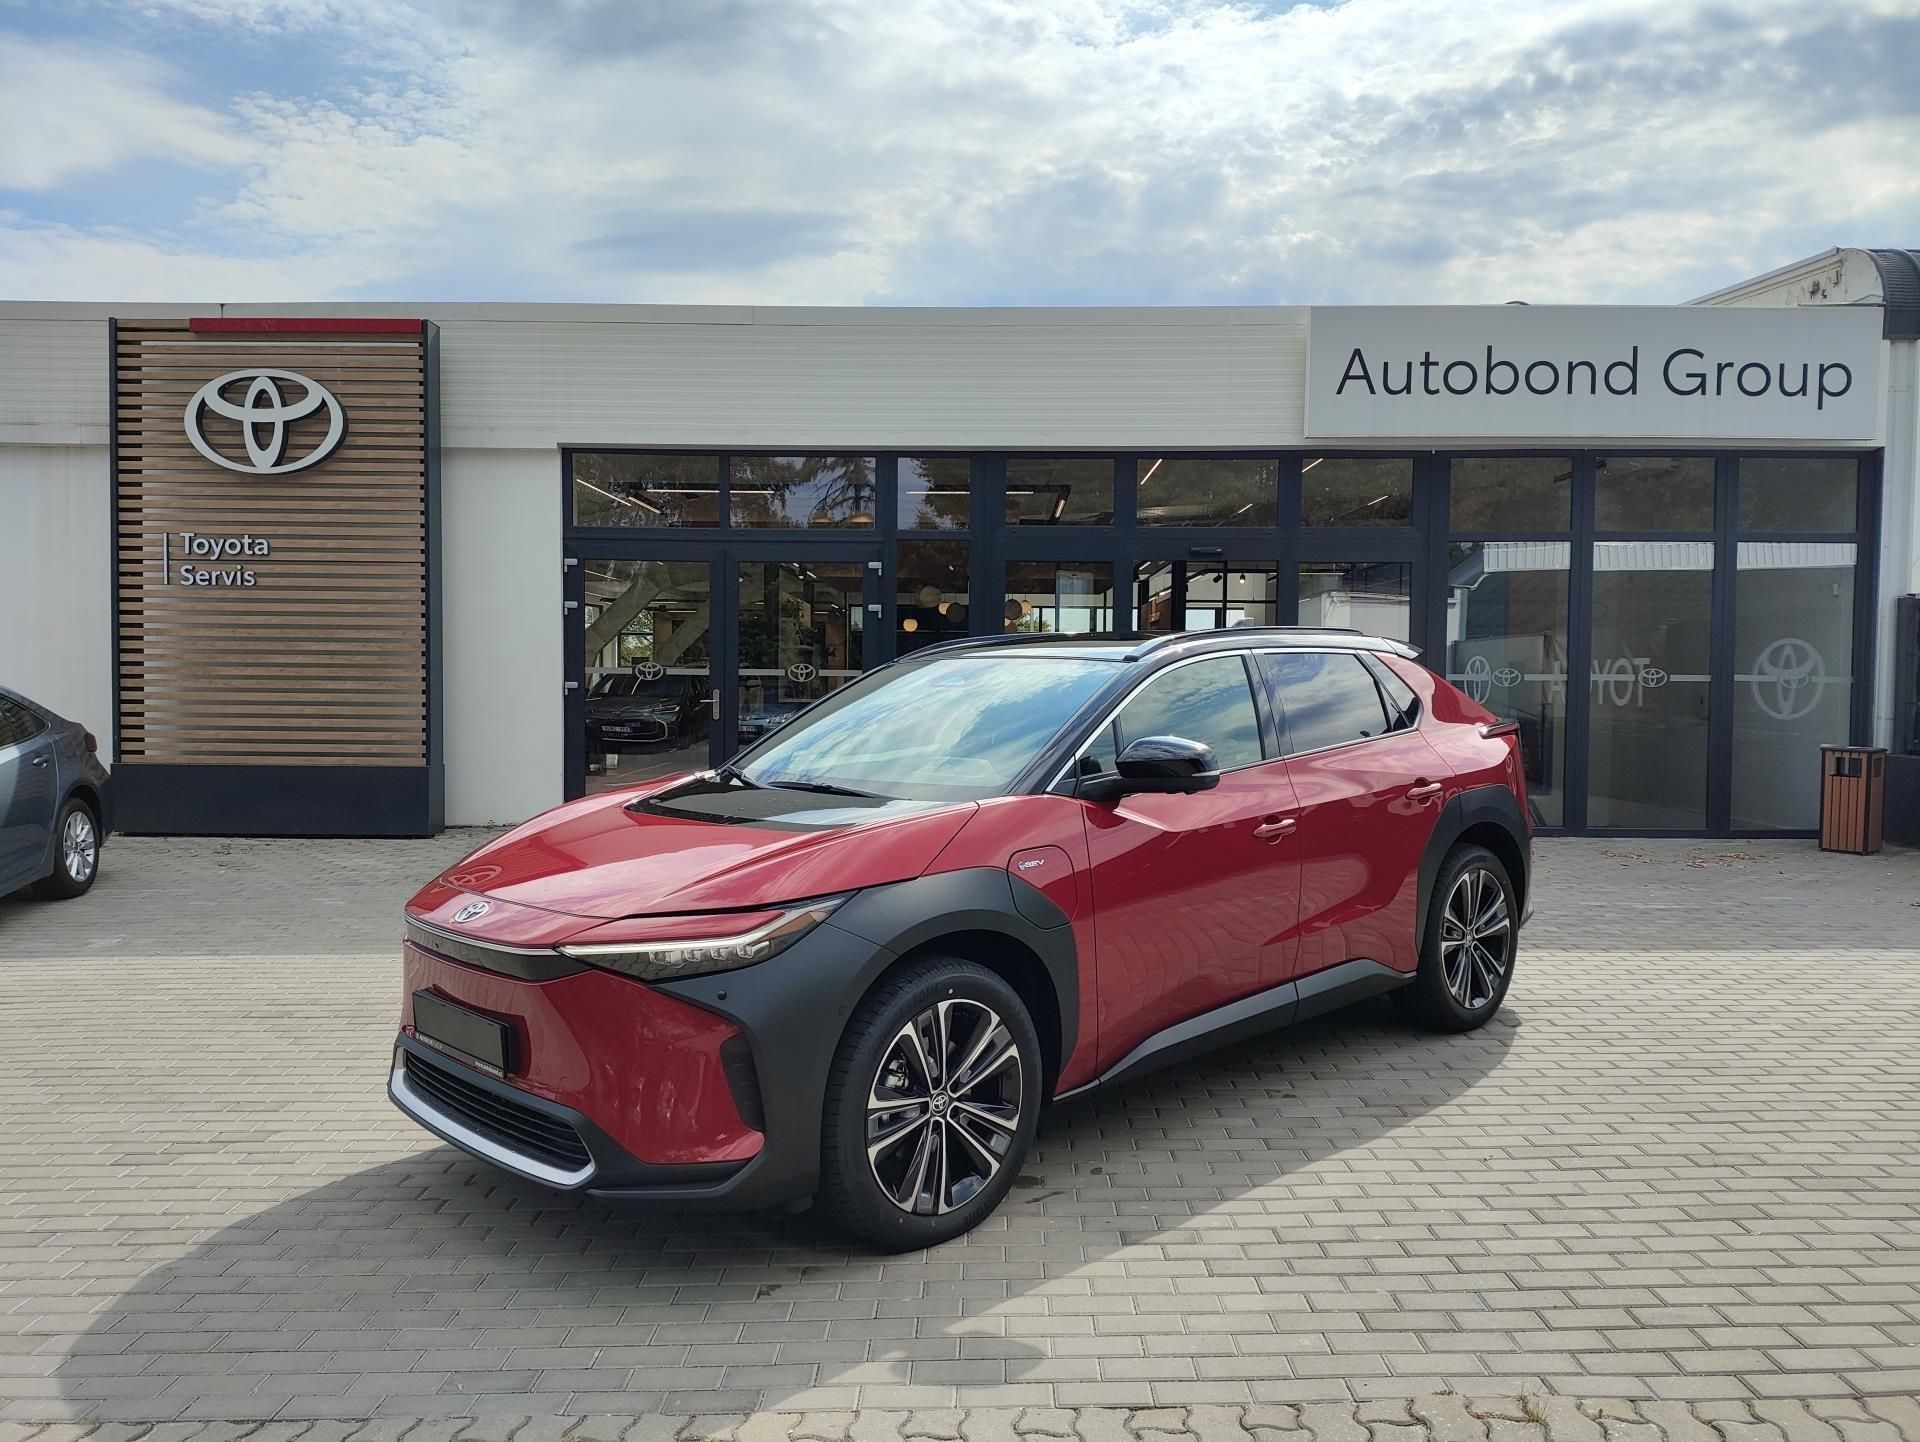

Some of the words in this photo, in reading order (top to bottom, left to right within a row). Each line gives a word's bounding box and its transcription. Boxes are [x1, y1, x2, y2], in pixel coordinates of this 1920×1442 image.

[1336, 345, 1639, 396] Autobond
[1663, 348, 1853, 410] Group
[180, 532, 269, 560] Toyota
[180, 565, 256, 586] Servis
